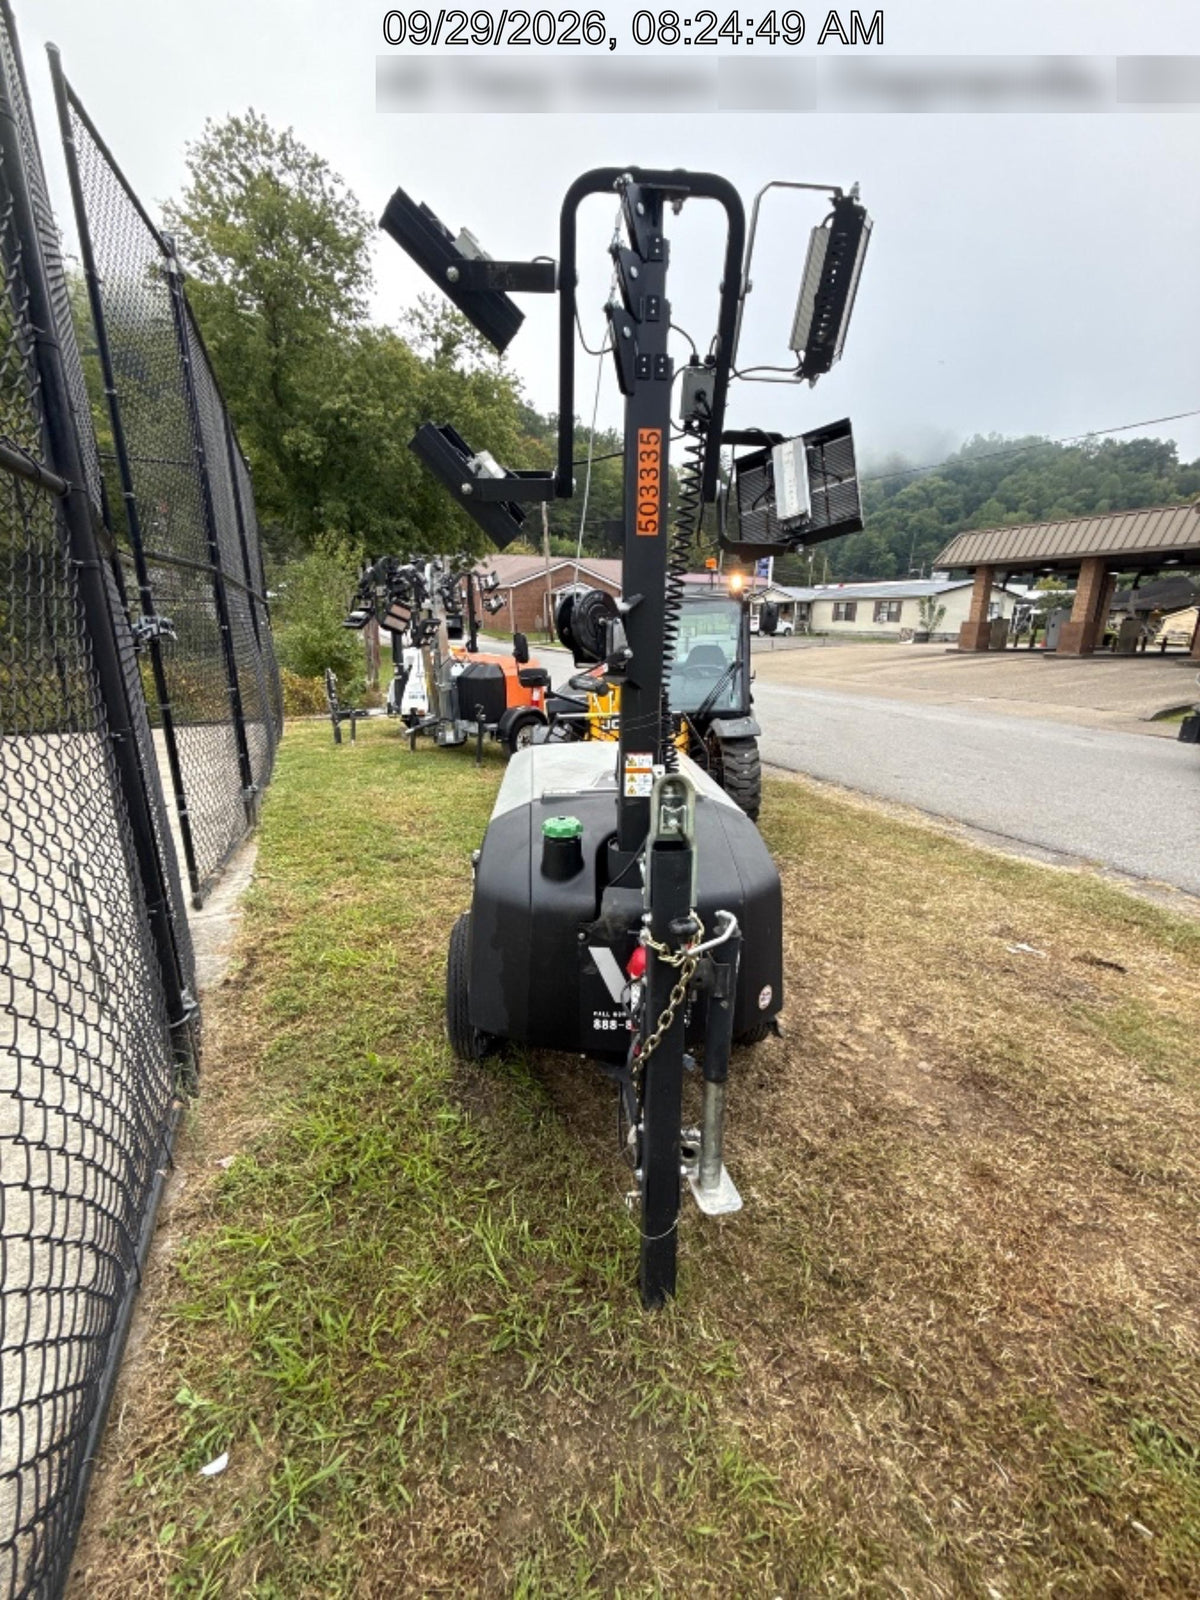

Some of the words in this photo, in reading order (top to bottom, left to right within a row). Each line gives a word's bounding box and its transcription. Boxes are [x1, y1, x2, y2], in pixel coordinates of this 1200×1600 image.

[637, 431, 661, 533] 503335
[601, 719, 620, 730] JC
[593, 1018, 632, 1031] 888-8
